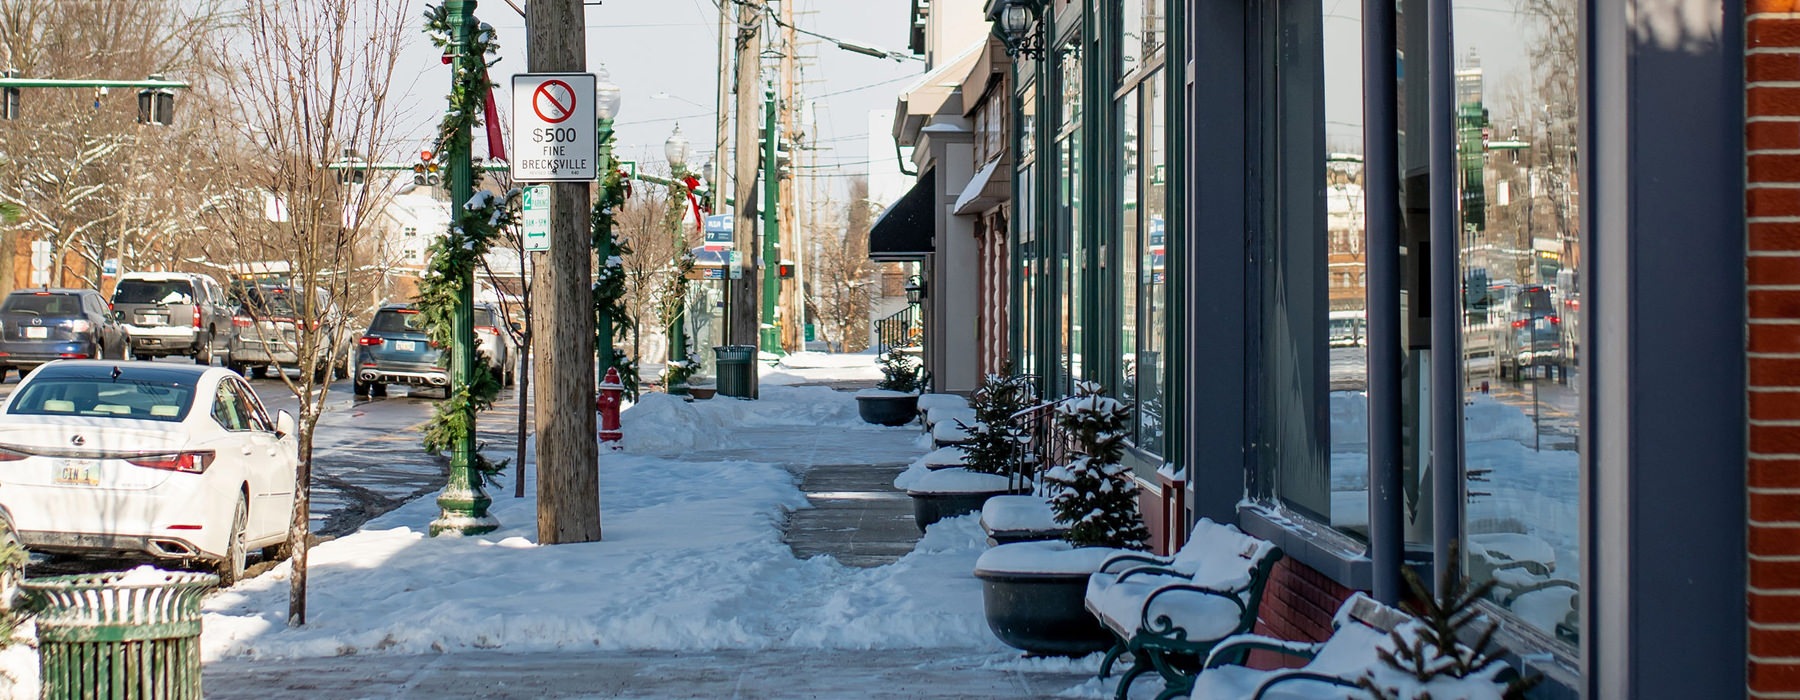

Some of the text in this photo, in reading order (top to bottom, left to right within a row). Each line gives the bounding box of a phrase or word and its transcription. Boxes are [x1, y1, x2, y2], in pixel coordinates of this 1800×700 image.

[532, 128, 576, 143] $500
[543, 146, 565, 155] FINE
[522, 159, 587, 170] BRECKSVILLE
[524, 191, 531, 206] 2
[62, 468, 79, 480] CIN
